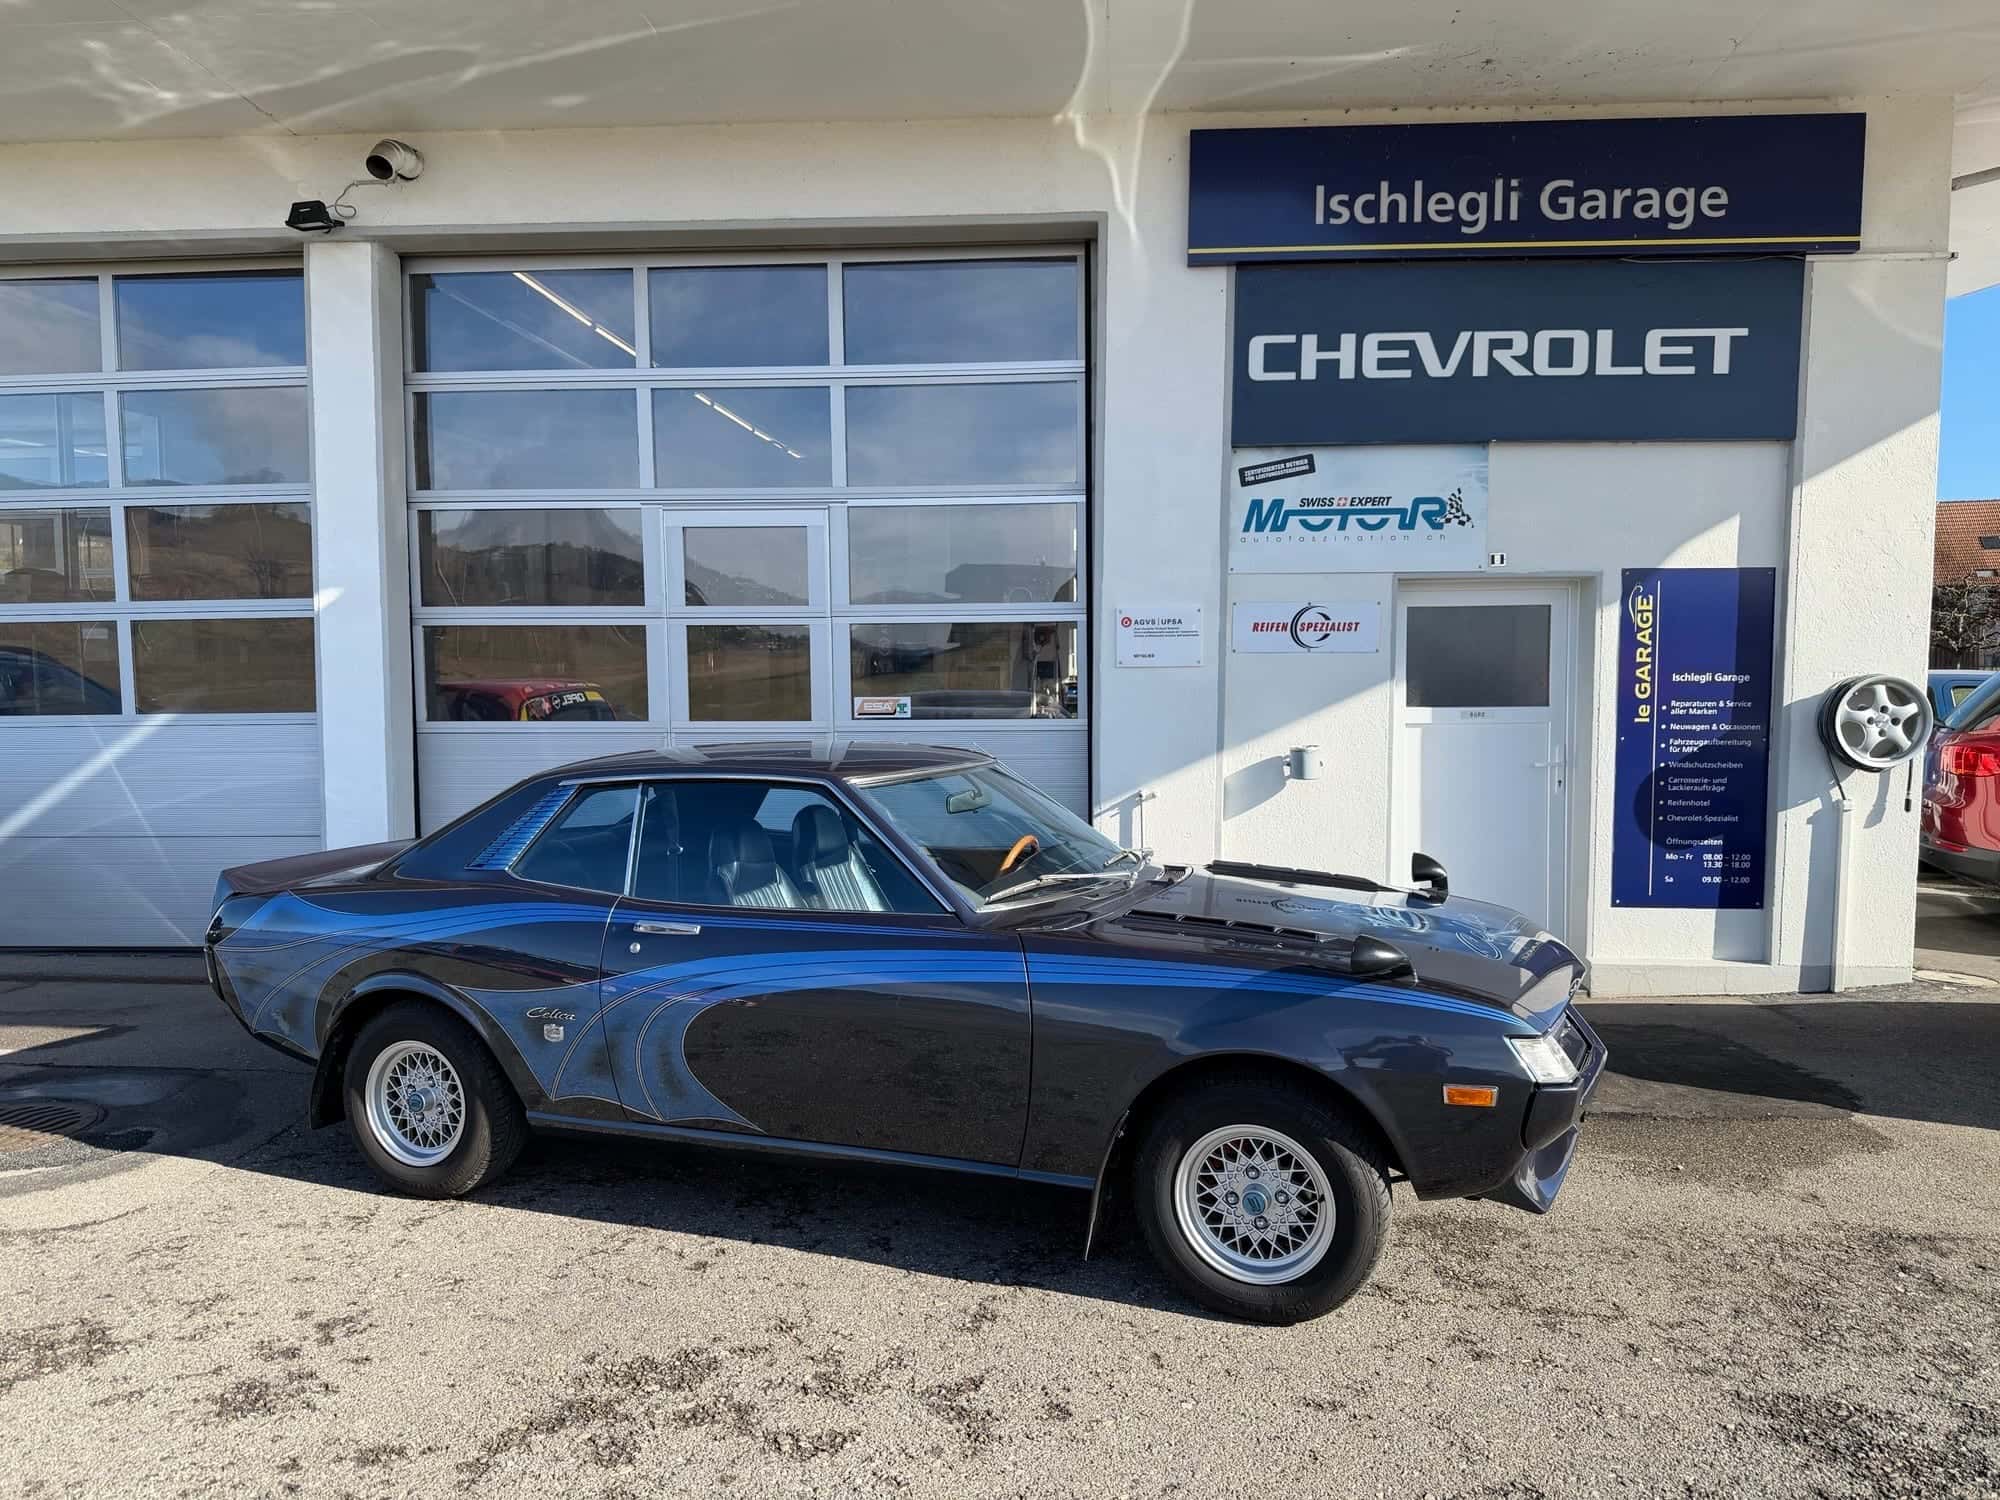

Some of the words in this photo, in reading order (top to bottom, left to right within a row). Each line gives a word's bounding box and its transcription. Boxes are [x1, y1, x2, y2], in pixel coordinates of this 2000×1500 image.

[1314, 178, 1520, 234] Ischlegli
[1539, 178, 1729, 234] Garage
[1247, 327, 1749, 382] CHEVROLET
[1299, 497, 1335, 508] SWISS
[1350, 496, 1392, 507] EXPERT
[1252, 622, 1289, 633] REIFEN
[1299, 621, 1361, 632] SPEZIALIST
[1634, 594, 1654, 699] GARAGE
[1672, 672, 1713, 684] Ischlegli
[1714, 672, 1751, 684] Garage
[1670, 700, 1718, 708] Reparaturen
[1634, 704, 1651, 723] le
[1670, 723, 1711, 731] Neuwagen
[1669, 738, 1752, 747] Fahrzeugaufbereitung
[1668, 761, 1744, 769] Windschutzscheiben
[1667, 784, 1726, 792] Lackieraufträge
[1665, 837, 1724, 846] Öffnungszeiten
[1664, 875, 1674, 883] Sa
[526, 1006, 577, 1021] Celica
